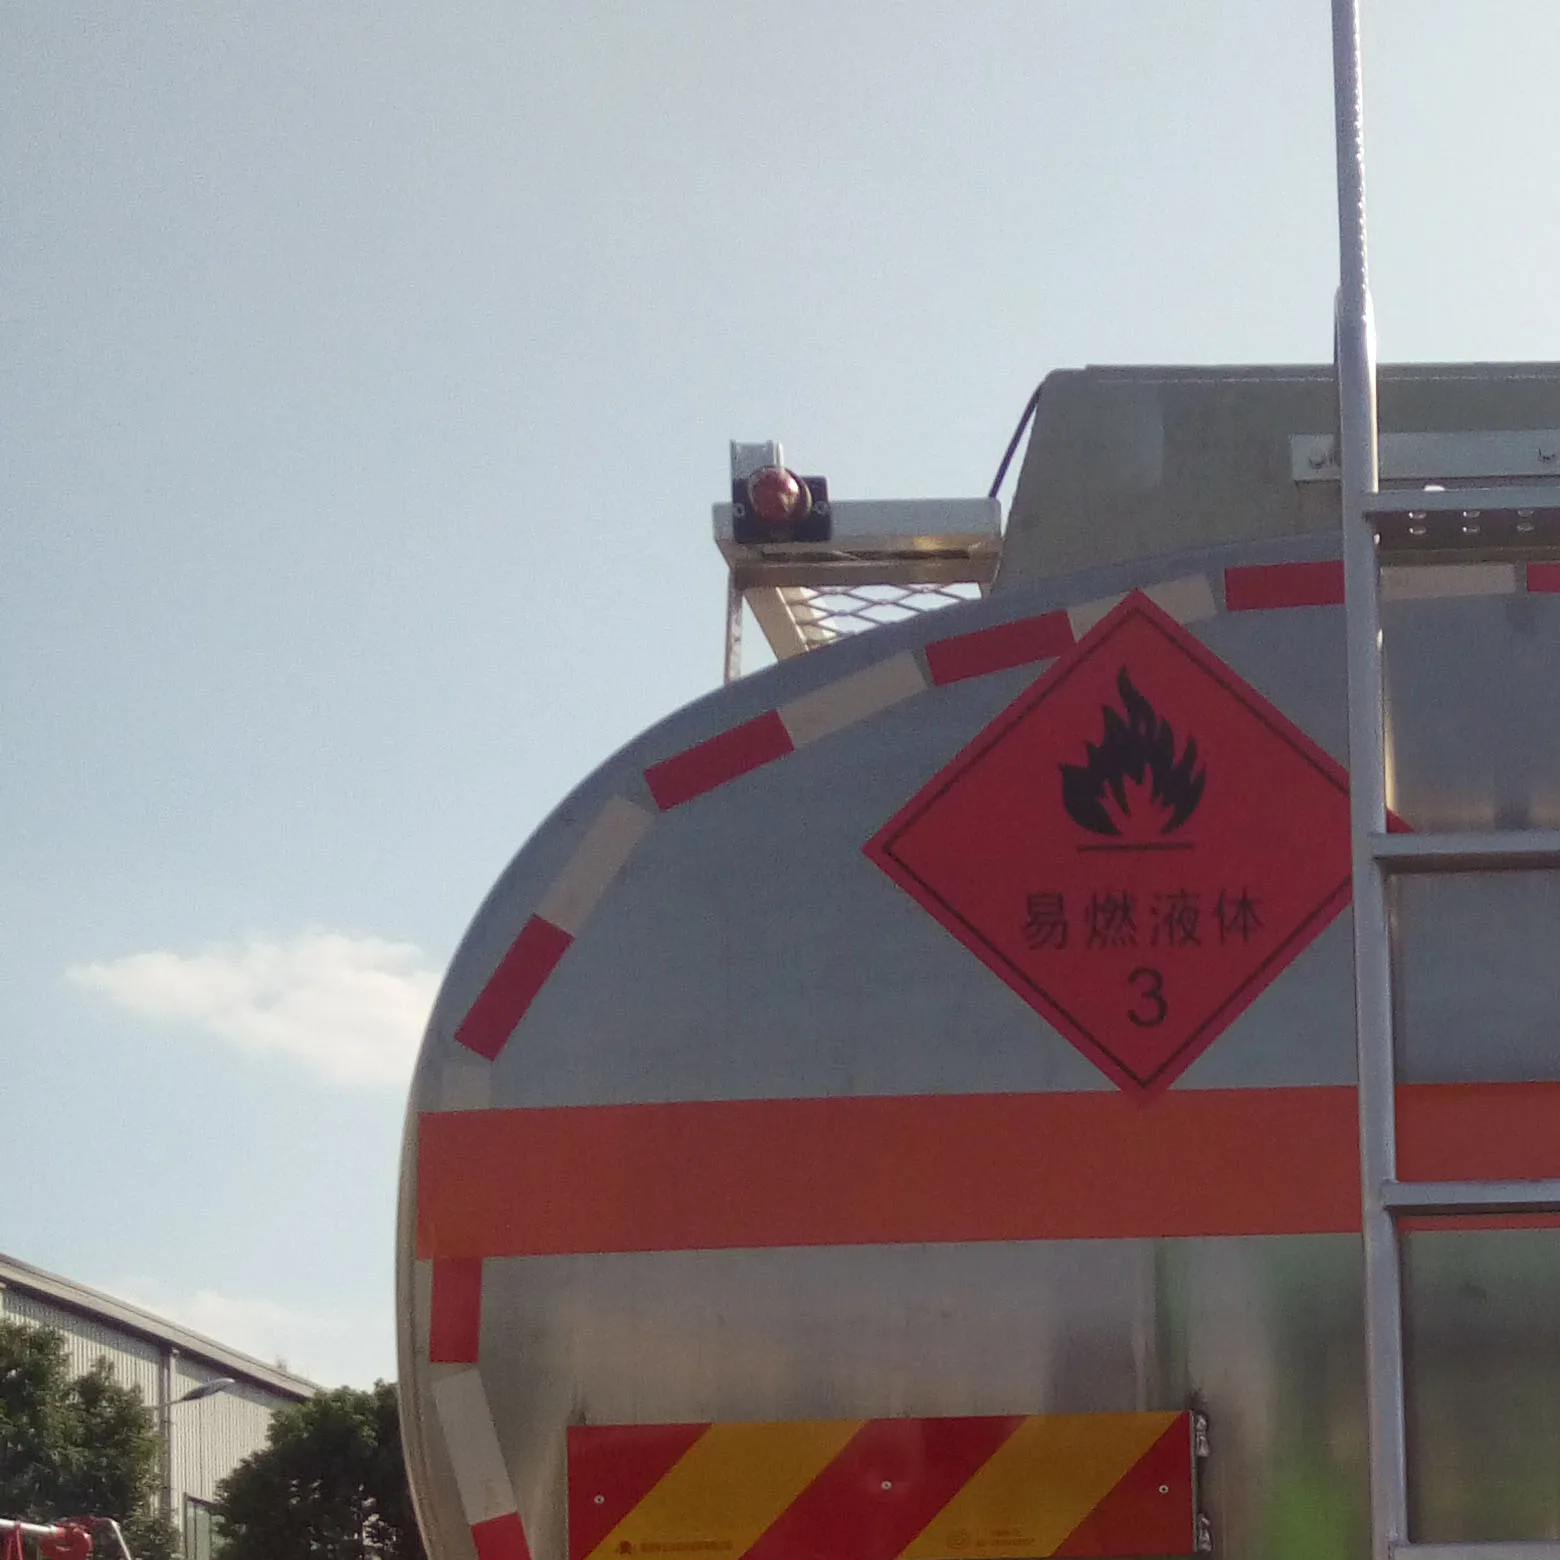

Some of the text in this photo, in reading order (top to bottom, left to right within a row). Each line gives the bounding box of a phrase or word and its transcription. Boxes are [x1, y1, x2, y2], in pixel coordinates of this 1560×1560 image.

[1022, 886, 1265, 951] 易燃液体
[1127, 966, 1168, 1028] 3
